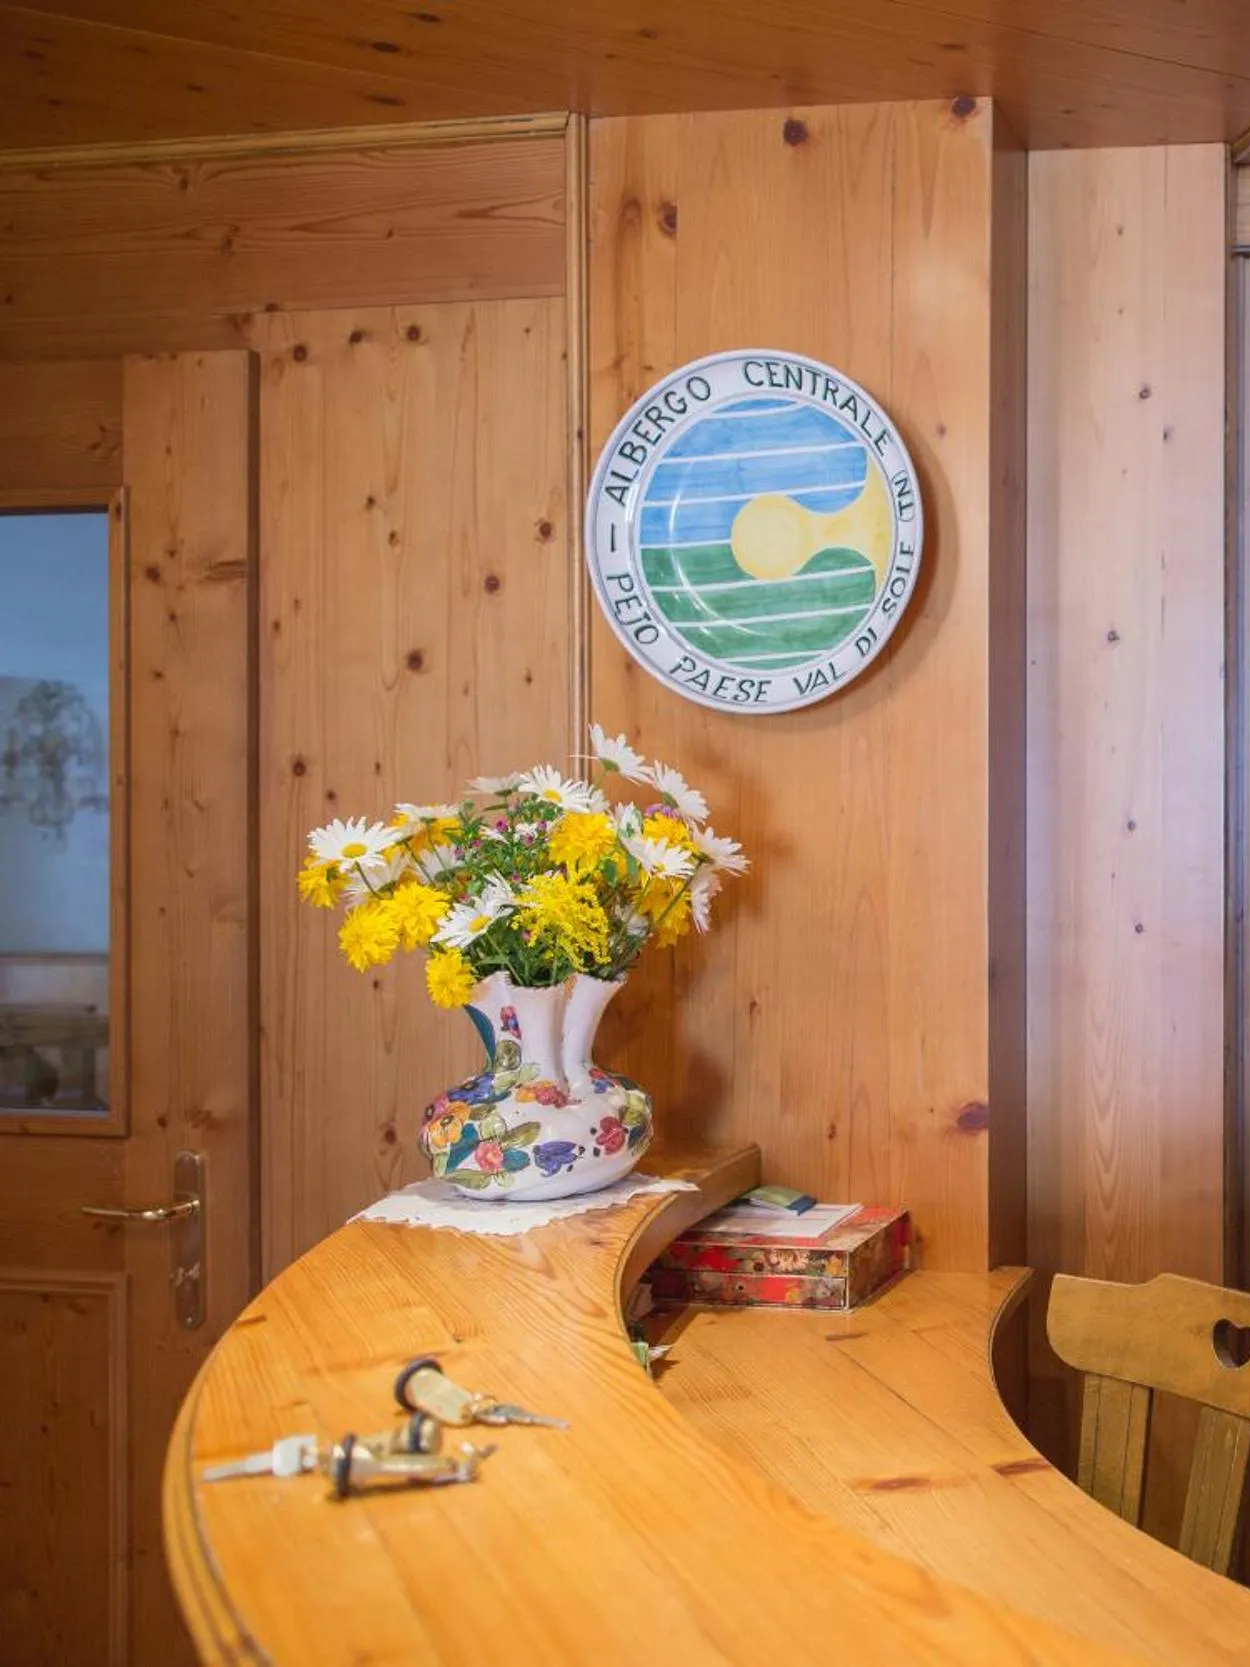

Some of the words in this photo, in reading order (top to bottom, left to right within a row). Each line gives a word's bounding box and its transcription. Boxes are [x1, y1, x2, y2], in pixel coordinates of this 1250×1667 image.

[604, 375, 712, 507] ALBERGO
[743, 360, 893, 457] CENTRALE
[606, 573, 660, 646] PEJO
[669, 656, 772, 702] PAESE
[792, 661, 847, 695] VAL
[854, 628, 878, 657] DI
[882, 541, 915, 621] SOLE
